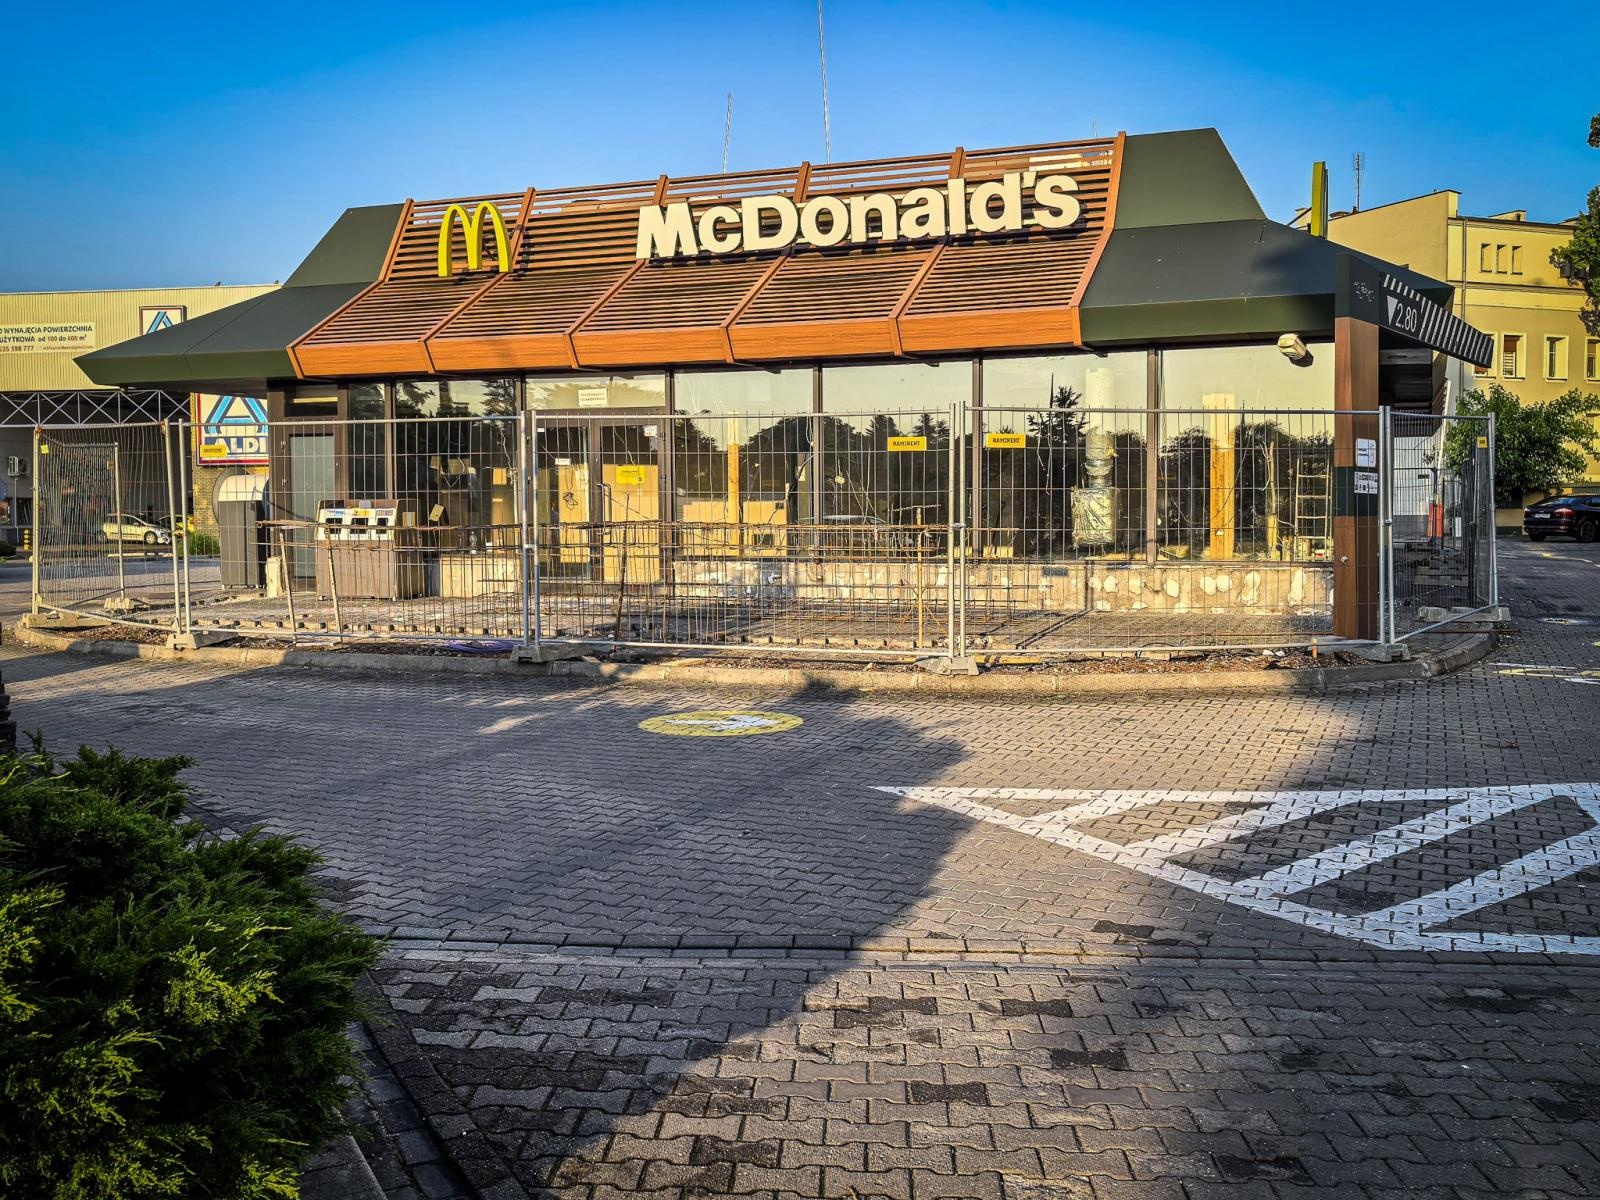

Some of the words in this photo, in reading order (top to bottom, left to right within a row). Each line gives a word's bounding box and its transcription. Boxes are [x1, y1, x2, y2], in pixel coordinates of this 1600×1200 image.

[636, 171, 1081, 259] McDonald's
[1395, 303, 1418, 332] 2.80
[4, 327, 42, 335] WYNAJĘCIA
[213, 437, 267, 453] ALDI
